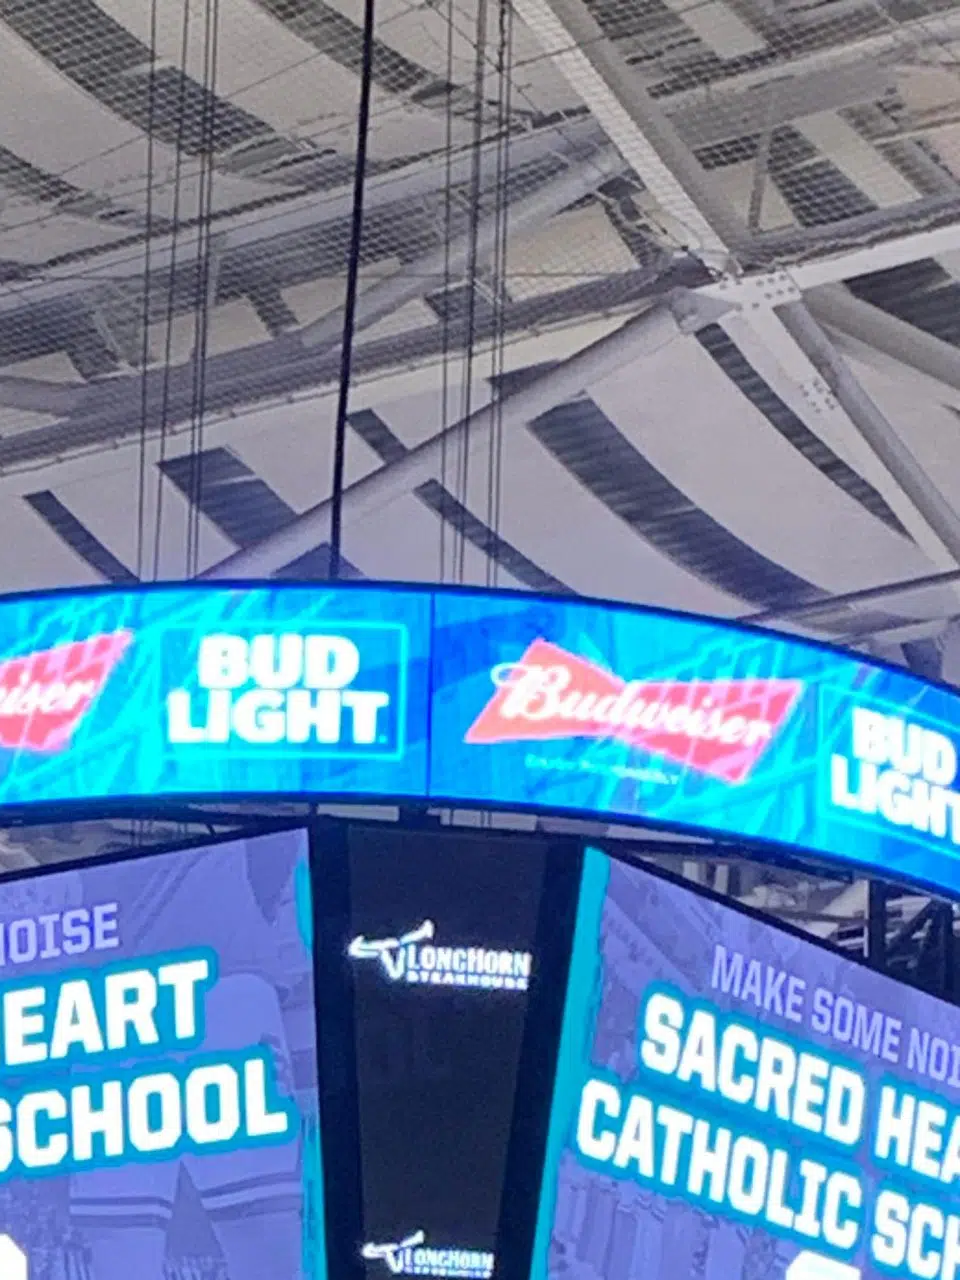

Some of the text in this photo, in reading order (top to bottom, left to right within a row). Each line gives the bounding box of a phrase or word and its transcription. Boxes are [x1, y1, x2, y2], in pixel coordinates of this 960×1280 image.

[197, 634, 359, 692] BUD
[168, 690, 389, 745] LIGHT
[491, 662, 773, 747] Budweiser
[852, 705, 957, 785] BUD
[408, 944, 532, 977] LONGHORN
[710, 945, 806, 1022] MAKE
[811, 988, 902, 1063] SOME
[641, 994, 866, 1146] SACRED
[576, 1080, 862, 1250] CATHOLIC
[405, 1248, 494, 1270] LONGHORN
